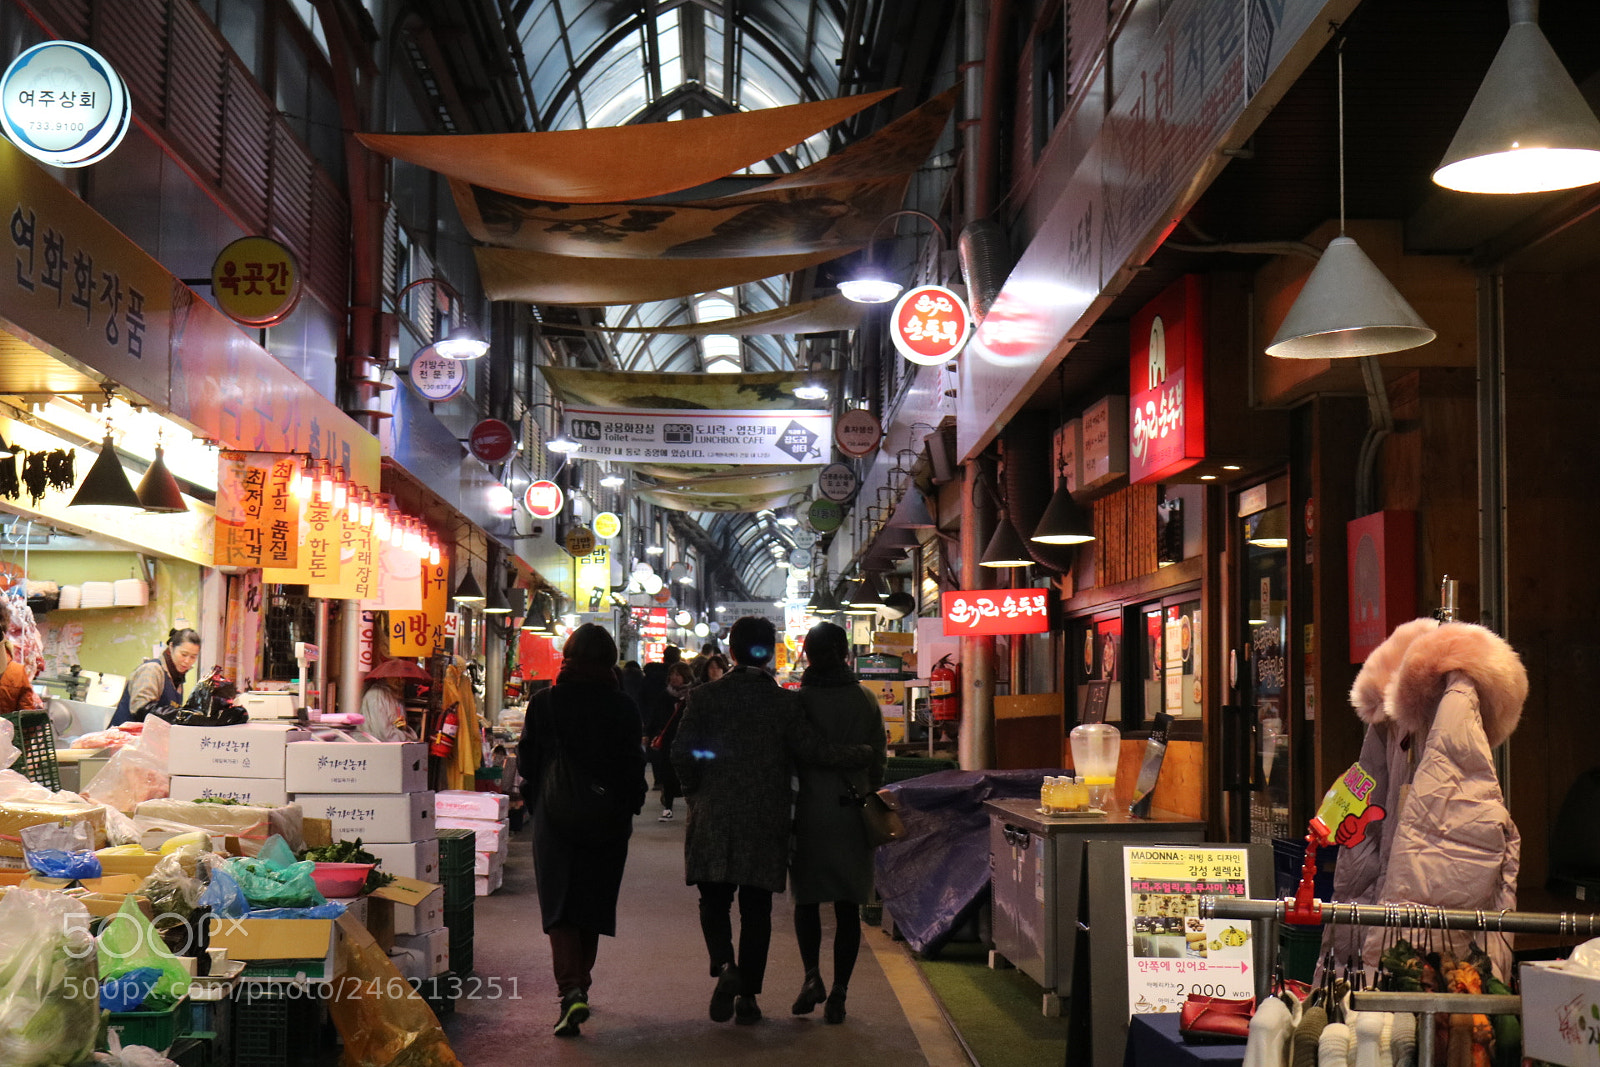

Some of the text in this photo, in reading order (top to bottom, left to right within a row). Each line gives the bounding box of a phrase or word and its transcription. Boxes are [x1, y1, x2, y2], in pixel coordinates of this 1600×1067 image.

[19, 90, 96, 109] 여주상회
[9, 204, 147, 360] 연화화장품
[420, 361, 456, 370] 가방수선
[604, 422, 655, 435] 공용화장실
[695, 425, 726, 435] 도시락
[604, 433, 629, 442] Toilet
[695, 436, 765, 444] LUNCHBOX CAFE
[245, 468, 267, 520] 최저의
[269, 462, 293, 561] 최고의 품질
[243, 528, 265, 565] 가격
[569, 537, 591, 550] 김밥
[308, 538, 330, 578] 한돈
[1000, 595, 1047, 618] 순두부
[1343, 764, 1374, 801] SALE
[1188, 854, 1204, 863] 리빙
[1217, 854, 1241, 864] 디자인
[1188, 866, 1243, 877] 감성 셀렉샵
[1226, 883, 1246, 895] 상품
[1138, 961, 1208, 974] 안쪽에 있어요
